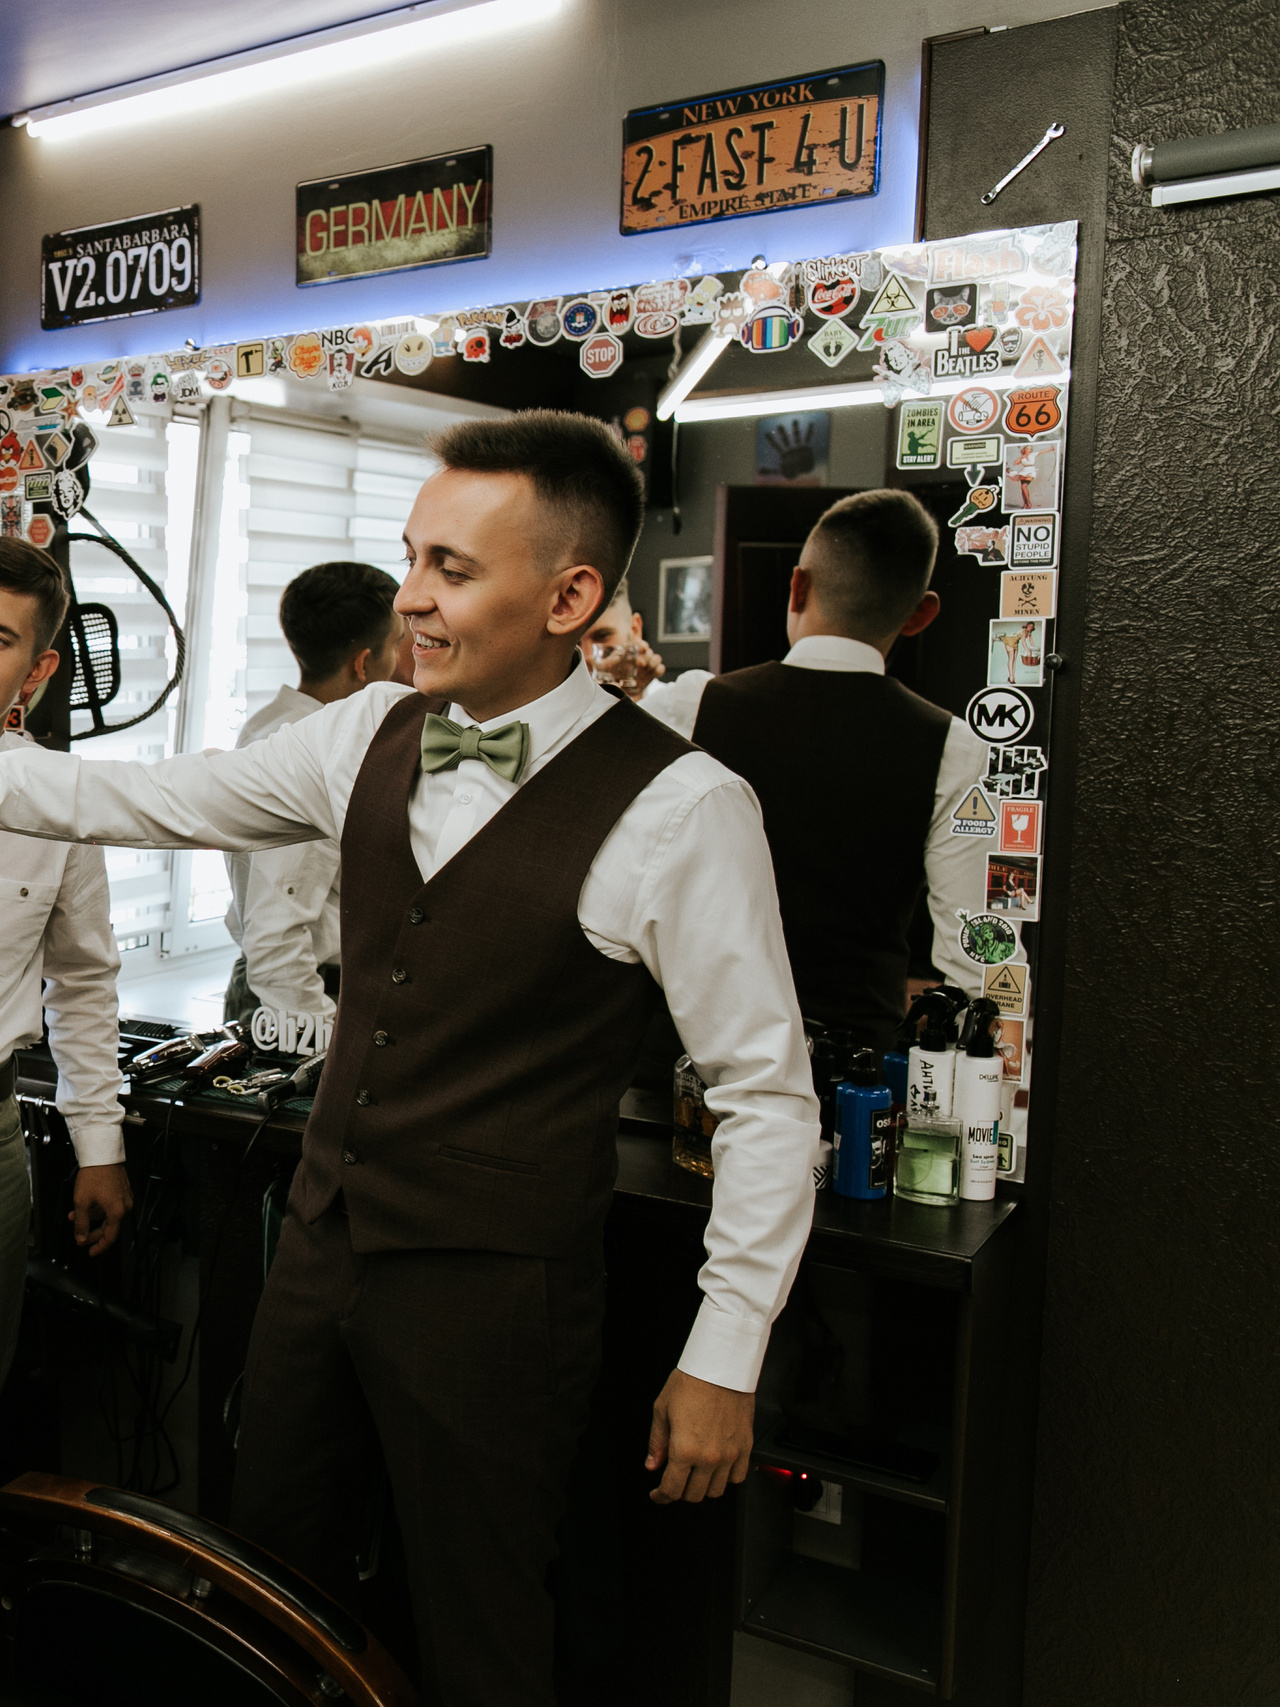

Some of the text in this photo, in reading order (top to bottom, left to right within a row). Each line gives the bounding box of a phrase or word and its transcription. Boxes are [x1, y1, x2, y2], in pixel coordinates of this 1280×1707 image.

[681, 83, 815, 126] NEW YORK
[631, 102, 867, 207] 2 FAST 4 U
[679, 183, 812, 220] EMPIRE STATE
[305, 178, 483, 257] GERMANY
[76, 222, 190, 258] SANTABARBARA
[935, 240, 1019, 279] Flash
[48, 236, 192, 312] V2.0709
[321, 327, 355, 348] NBC
[587, 347, 615, 363] STOP
[936, 350, 997, 377] BEATLES
[180, 387, 199, 398] JDM
[1018, 391, 1050, 400] ROUTE
[907, 407, 938, 418] ZOMBIES
[1015, 403, 1051, 428] 66
[907, 418, 936, 428] IN AREA
[903, 454, 935, 464] STAY ALERT
[1016, 525, 1050, 543] NO
[1016, 542, 1050, 551] STUPID
[1009, 574, 1048, 582] ACHTUNG
[8, 708, 21, 728] 3
[976, 703, 1023, 728] MK
[954, 826, 994, 834] ALLERGY
[985, 993, 1023, 1003] OVERHEAD
[968, 1127, 993, 1142] MOVIE
